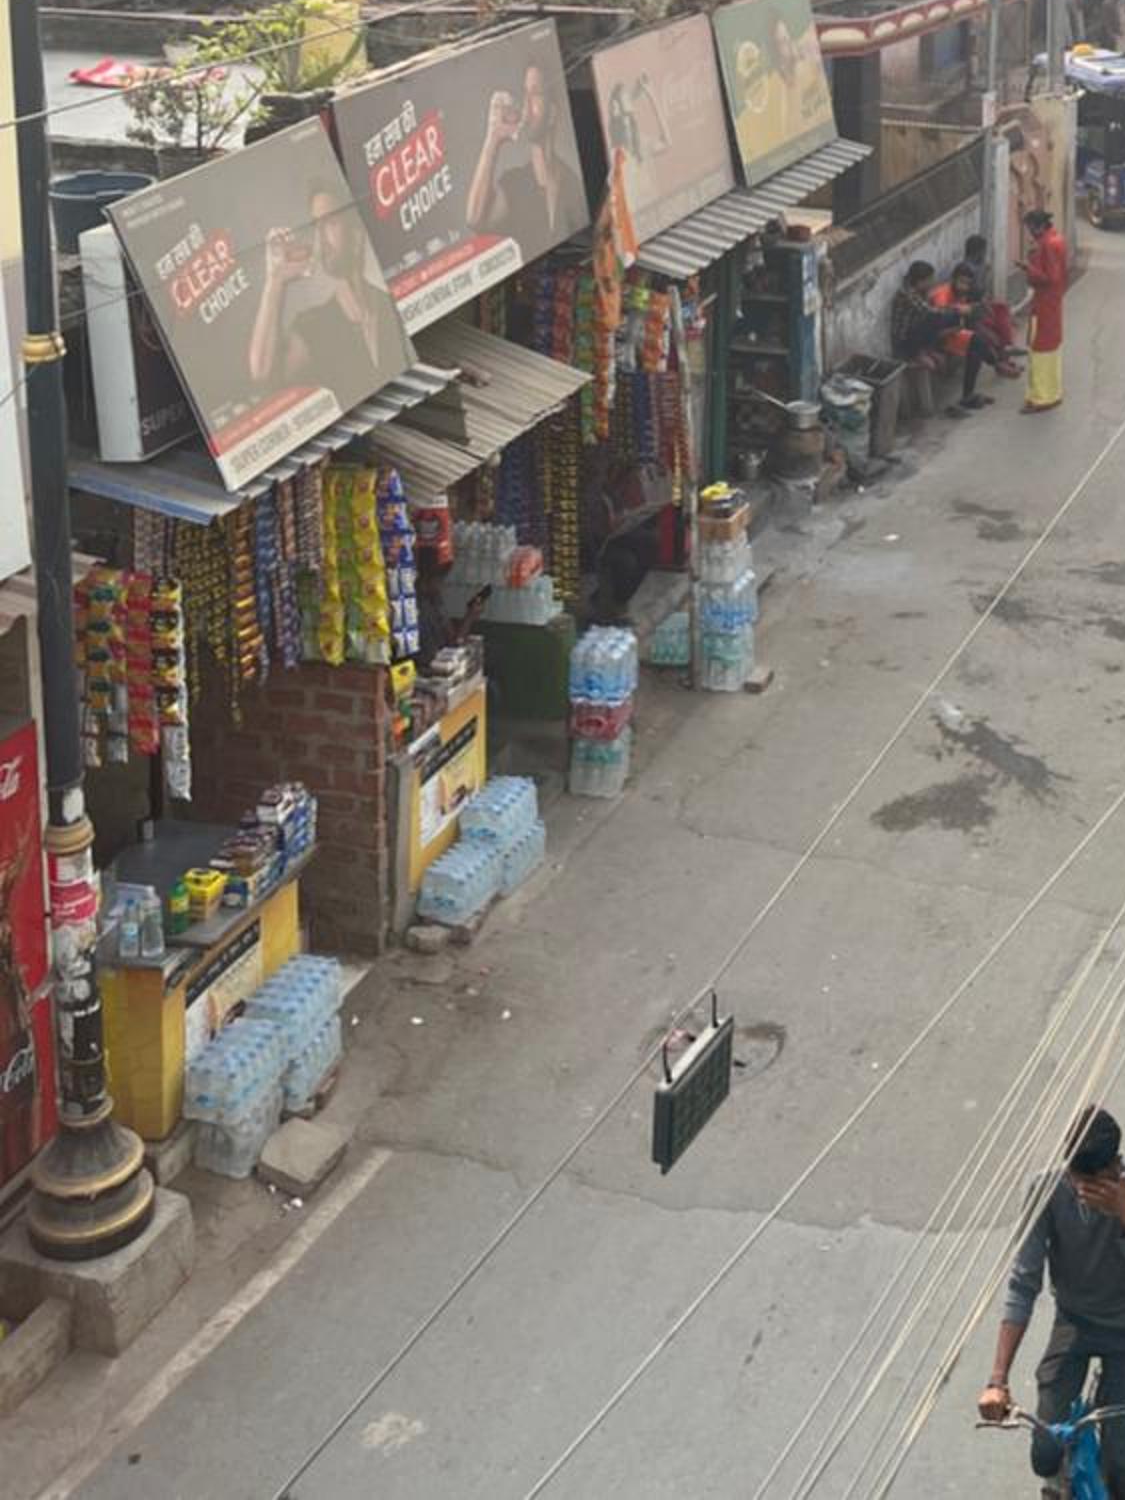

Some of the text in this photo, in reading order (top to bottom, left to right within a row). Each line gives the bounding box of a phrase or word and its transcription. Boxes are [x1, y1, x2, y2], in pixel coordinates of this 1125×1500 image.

[376, 124, 442, 207] CLEAR
[400, 164, 453, 231] CHOICE
[172, 239, 236, 309] CLEAR
[199, 267, 250, 325] CHOICE
